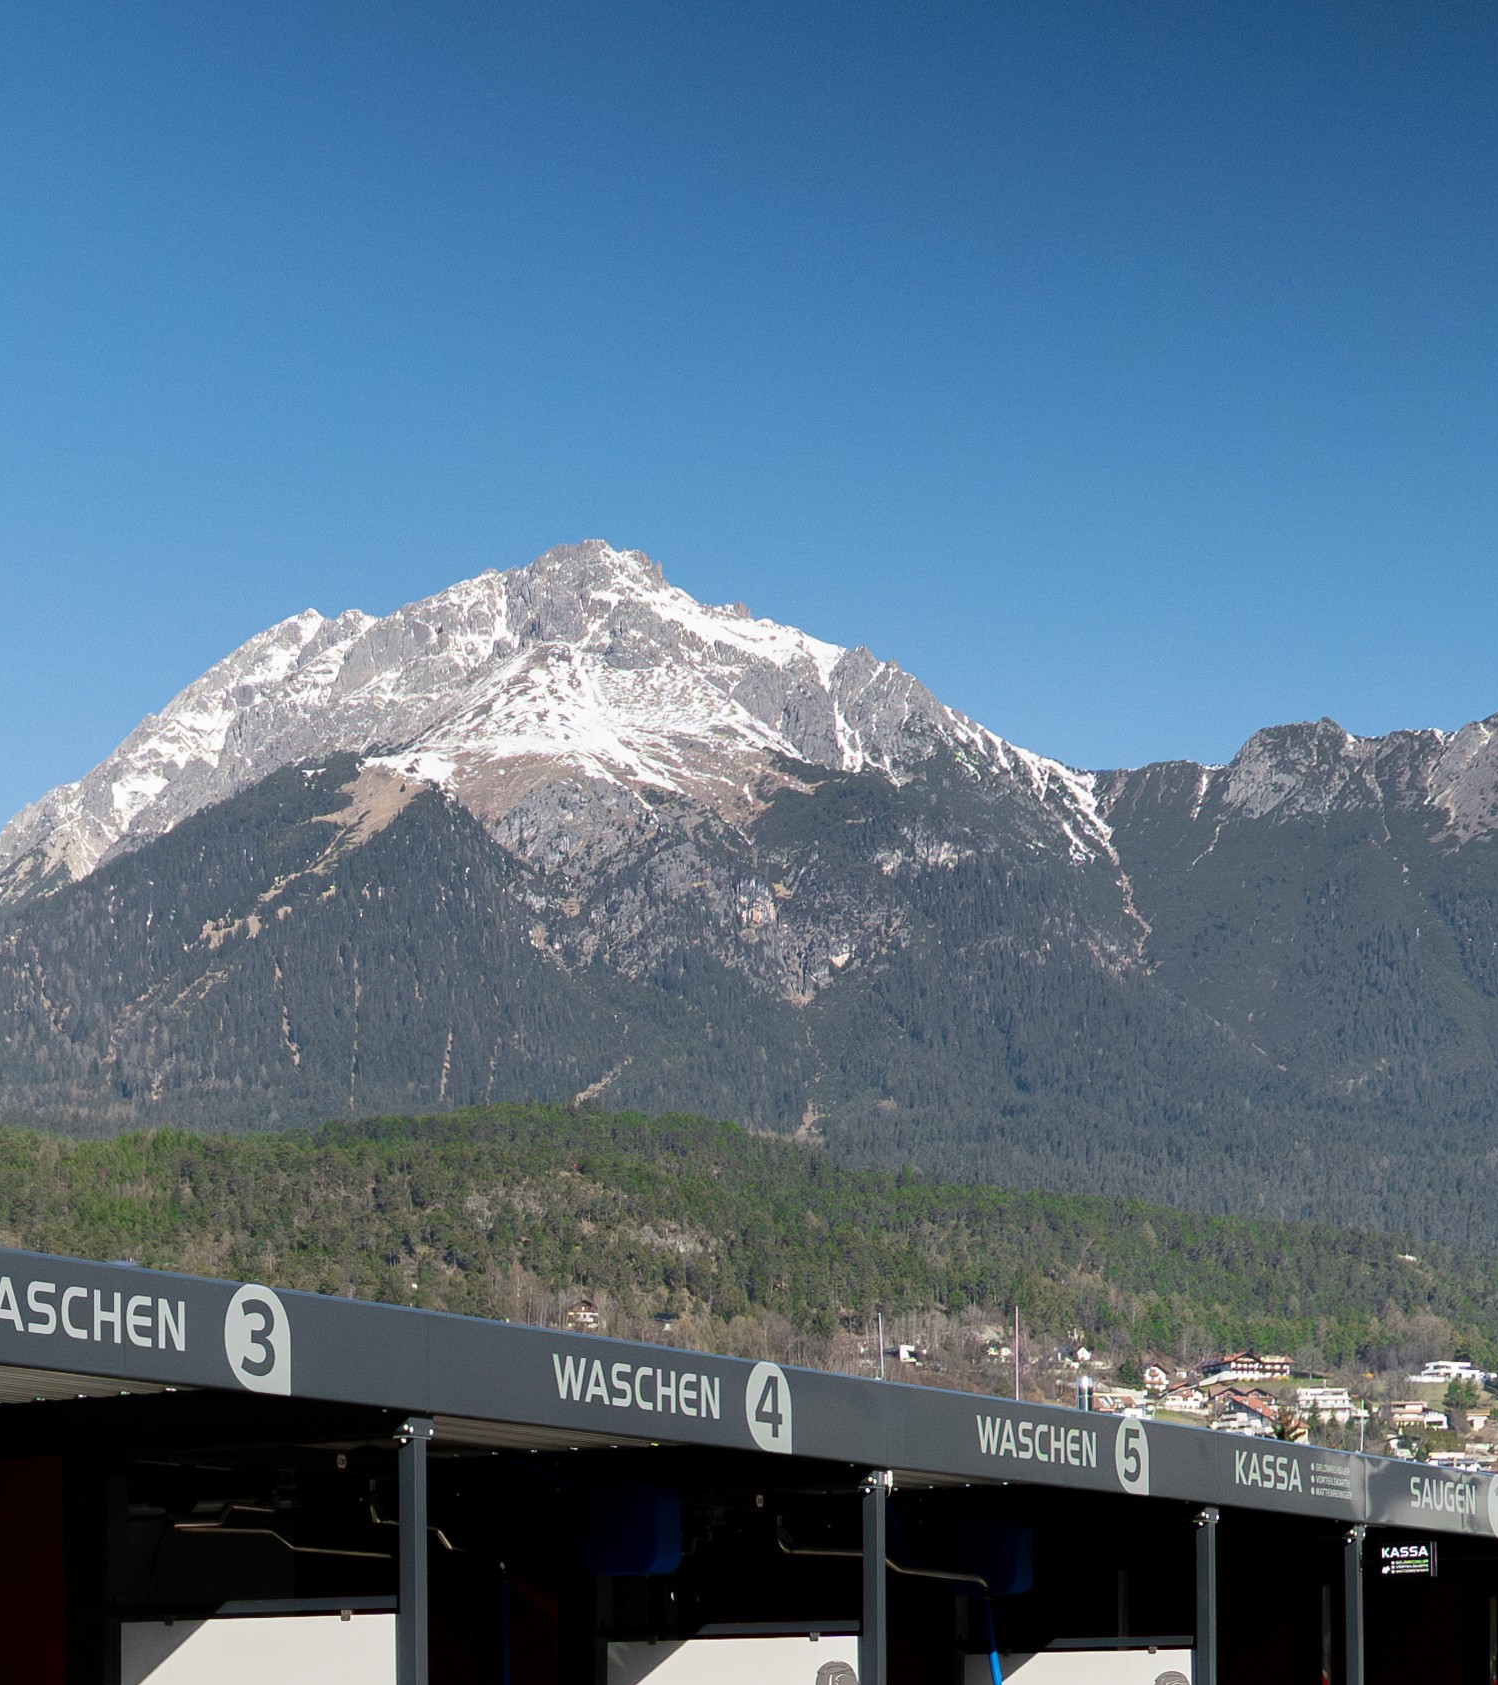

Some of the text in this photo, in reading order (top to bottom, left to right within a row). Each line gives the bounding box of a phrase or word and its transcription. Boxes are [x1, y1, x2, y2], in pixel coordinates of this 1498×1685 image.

[241, 1299, 275, 1377] 3
[552, 1353, 782, 1438] WASCHEN 4
[976, 1414, 1141, 1483] WASCHEN 5
[1235, 1450, 1303, 1493] KASSA
[1410, 1476, 1476, 1515] SAUGEN
[1381, 1545, 1429, 1559] KASSA
